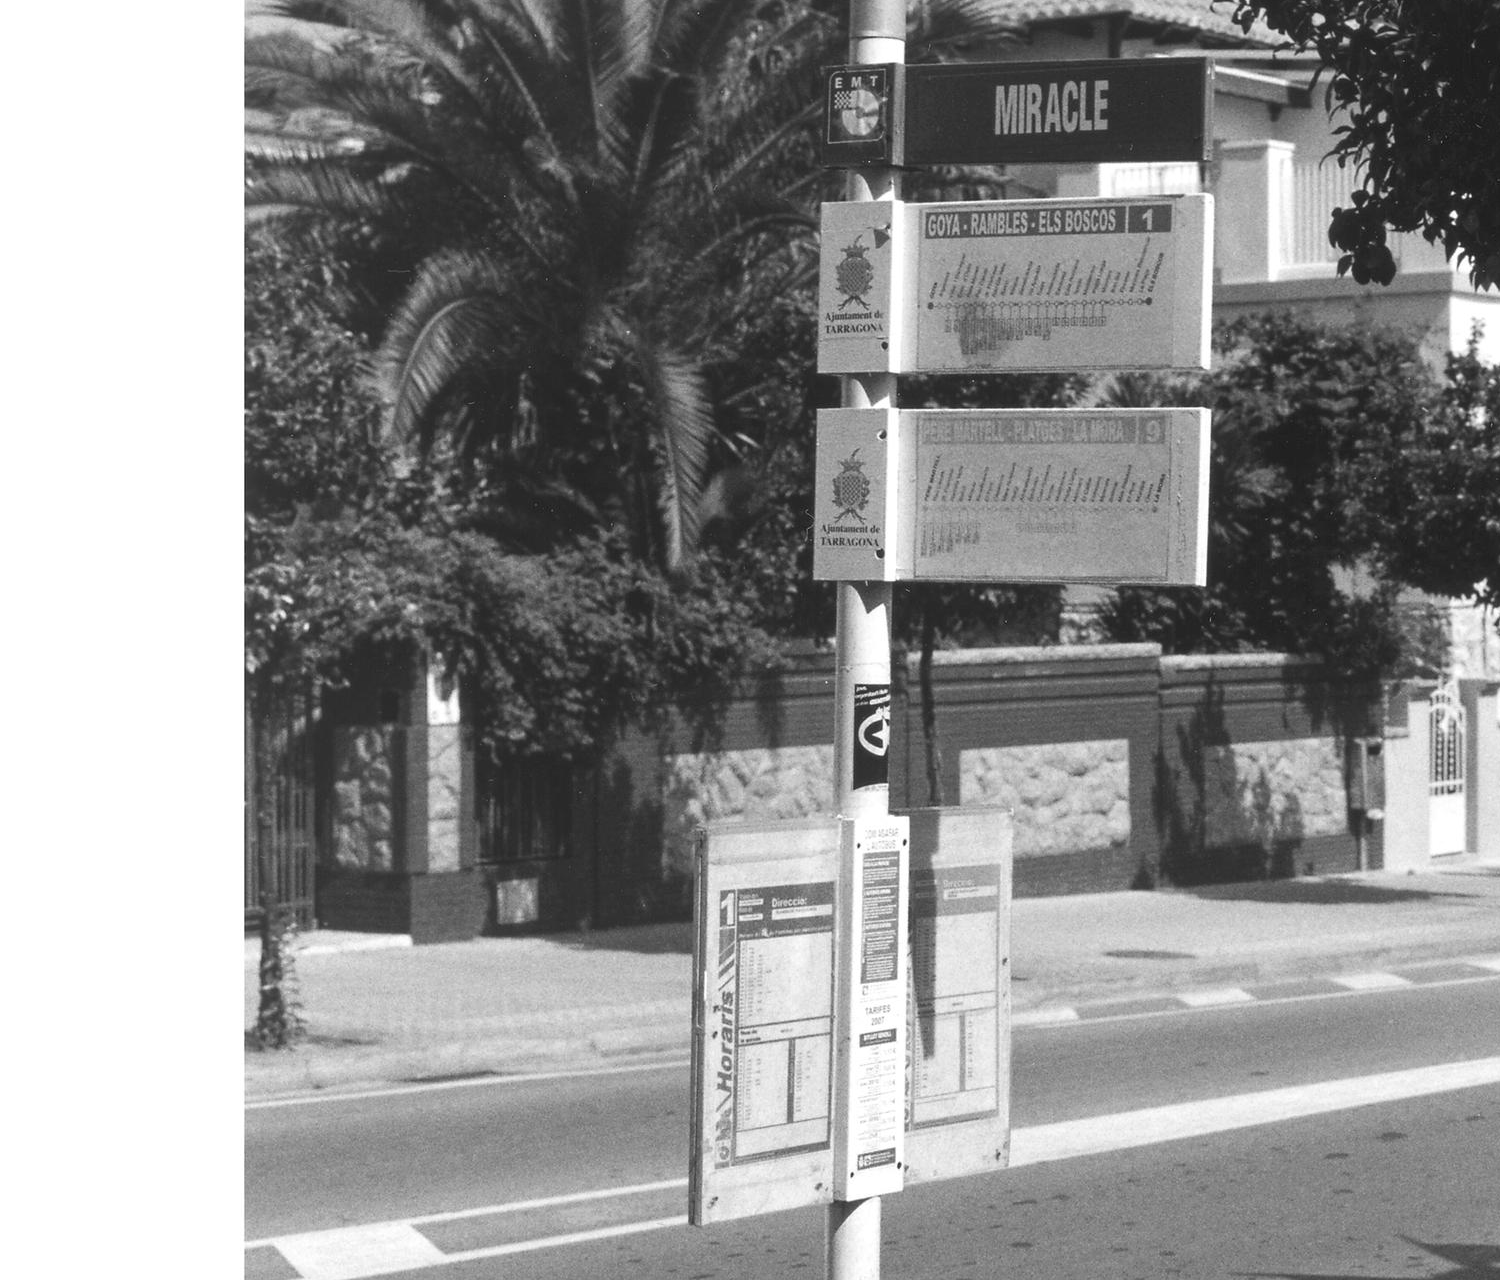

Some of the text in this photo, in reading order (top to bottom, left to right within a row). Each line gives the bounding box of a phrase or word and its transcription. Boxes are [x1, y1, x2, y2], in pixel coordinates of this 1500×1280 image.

[994, 80, 1110, 135] MIRACLE
[928, 213, 960, 237] GOYA
[970, 210, 1029, 235] RAMBLES
[1039, 209, 1062, 233] ELS
[1065, 208, 1117, 232] BOSCOS
[1141, 208, 1153, 231] 1
[824, 311, 884, 322] Ajuntament de
[824, 323, 884, 335] TARRAGONA
[1146, 419, 1160, 442] 9
[821, 523, 881, 535] Ajuntament de
[821, 536, 879, 548] TARRAGONA
[721, 892, 735, 926] 1
